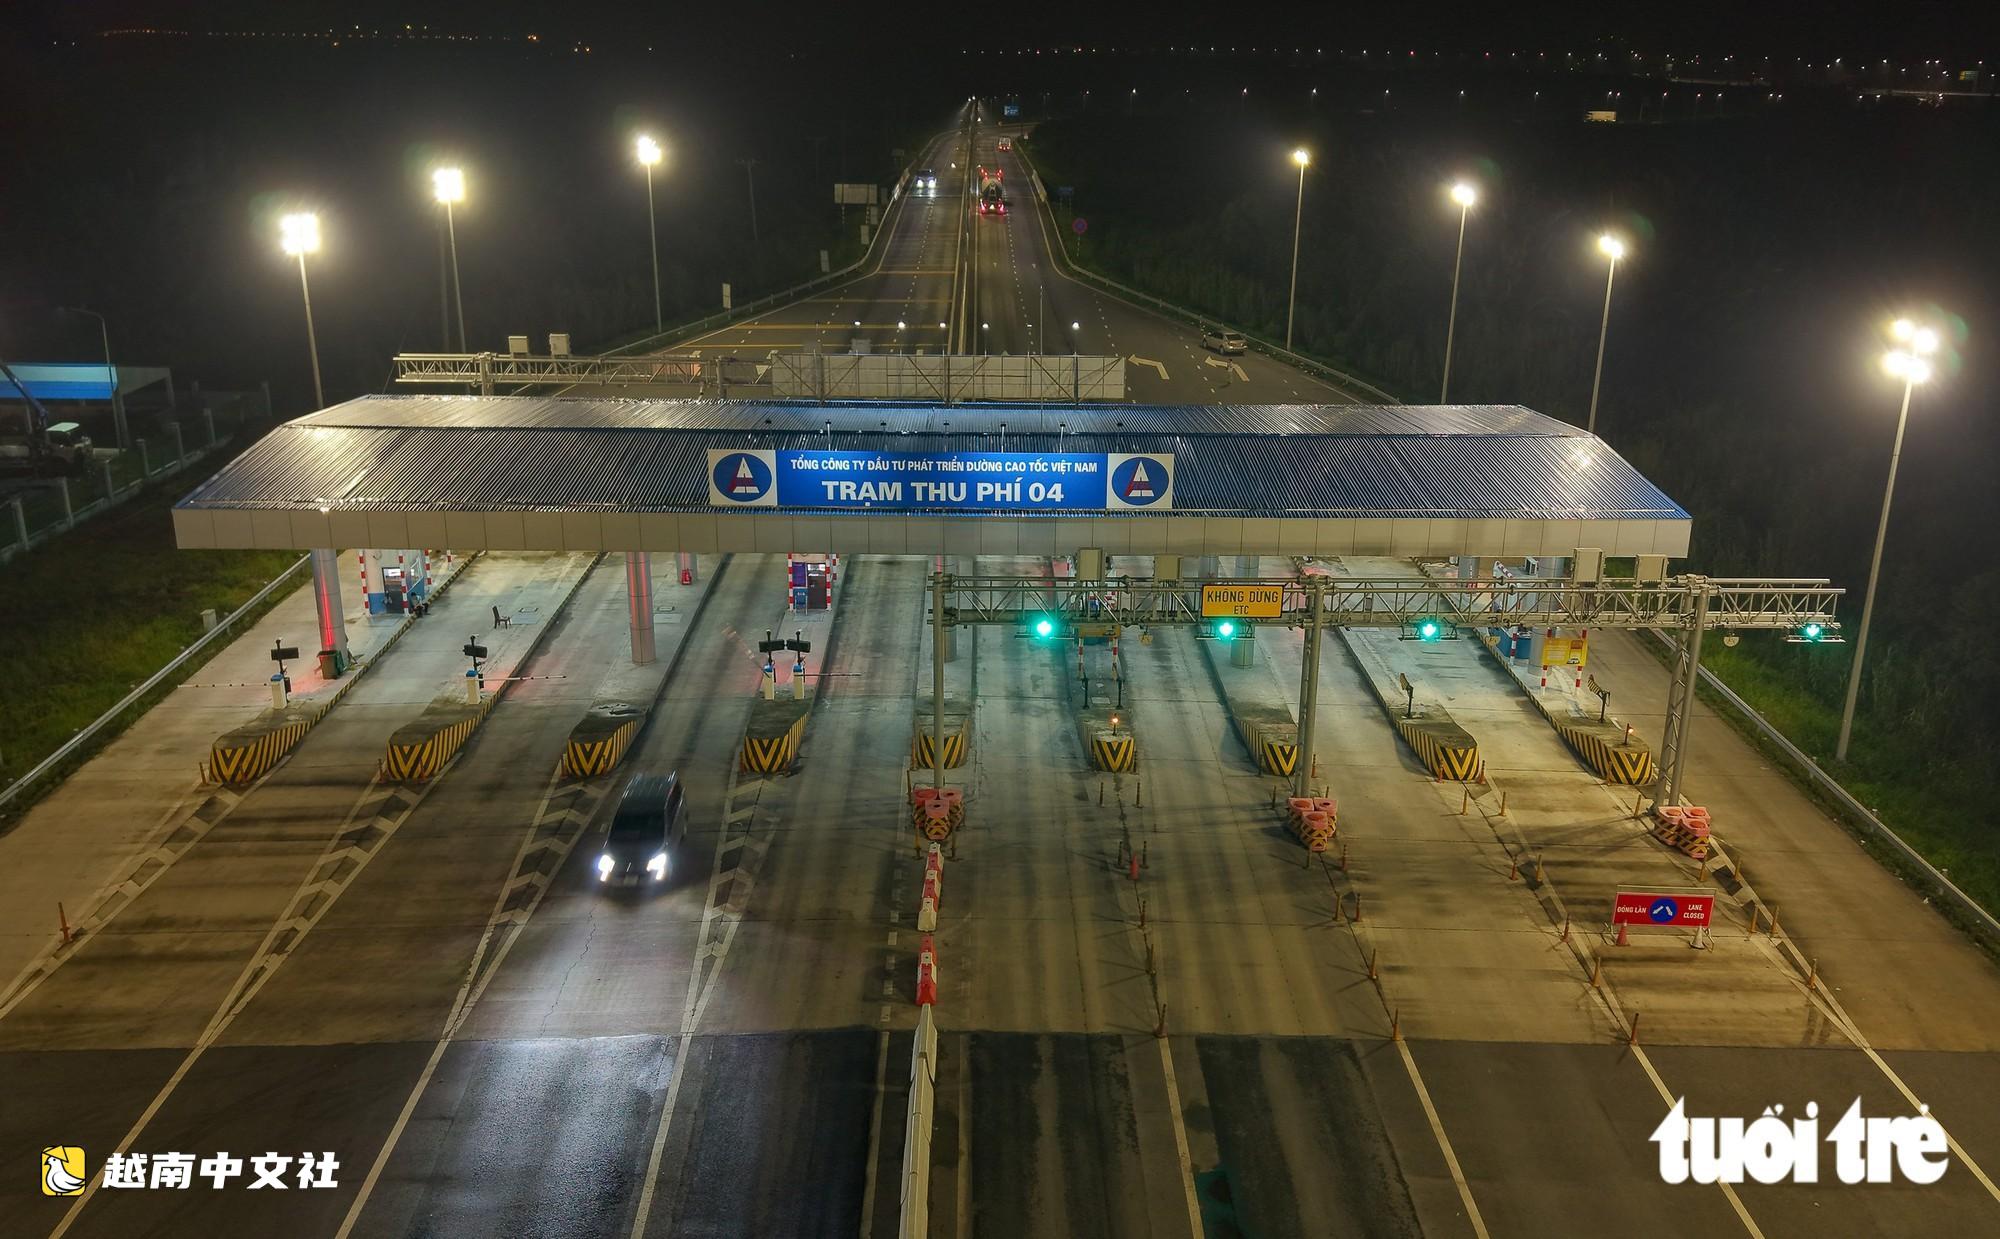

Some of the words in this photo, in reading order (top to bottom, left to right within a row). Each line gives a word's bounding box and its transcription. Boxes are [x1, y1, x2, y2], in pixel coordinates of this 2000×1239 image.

[791, 454, 819, 470] TỔNG
[821, 457, 850, 471] CÔNG
[852, 460, 865, 471] TY
[867, 456, 889, 471] ĐẦU
[892, 460, 906, 471] TƯ
[907, 458, 934, 471] PHÁT
[936, 456, 964, 472] TRIỂN
[966, 458, 1003, 472] ĐƯỜNG
[1005, 462, 1026, 472] CAO
[1029, 457, 1048, 472] TỐC
[1051, 460, 1072, 475] VIỆT
[1074, 462, 1097, 473] NAM
[821, 480, 902, 507] TRẠM
[911, 482, 967, 502] THU
[977, 477, 1023, 502] PHÍ
[1028, 482, 1064, 502] 04
[1207, 588, 1244, 603] KHÔNG
[1249, 588, 1278, 603] DỪNG
[1234, 605, 1249, 615] ETC
[1683, 912, 1705, 920] CLOSED
